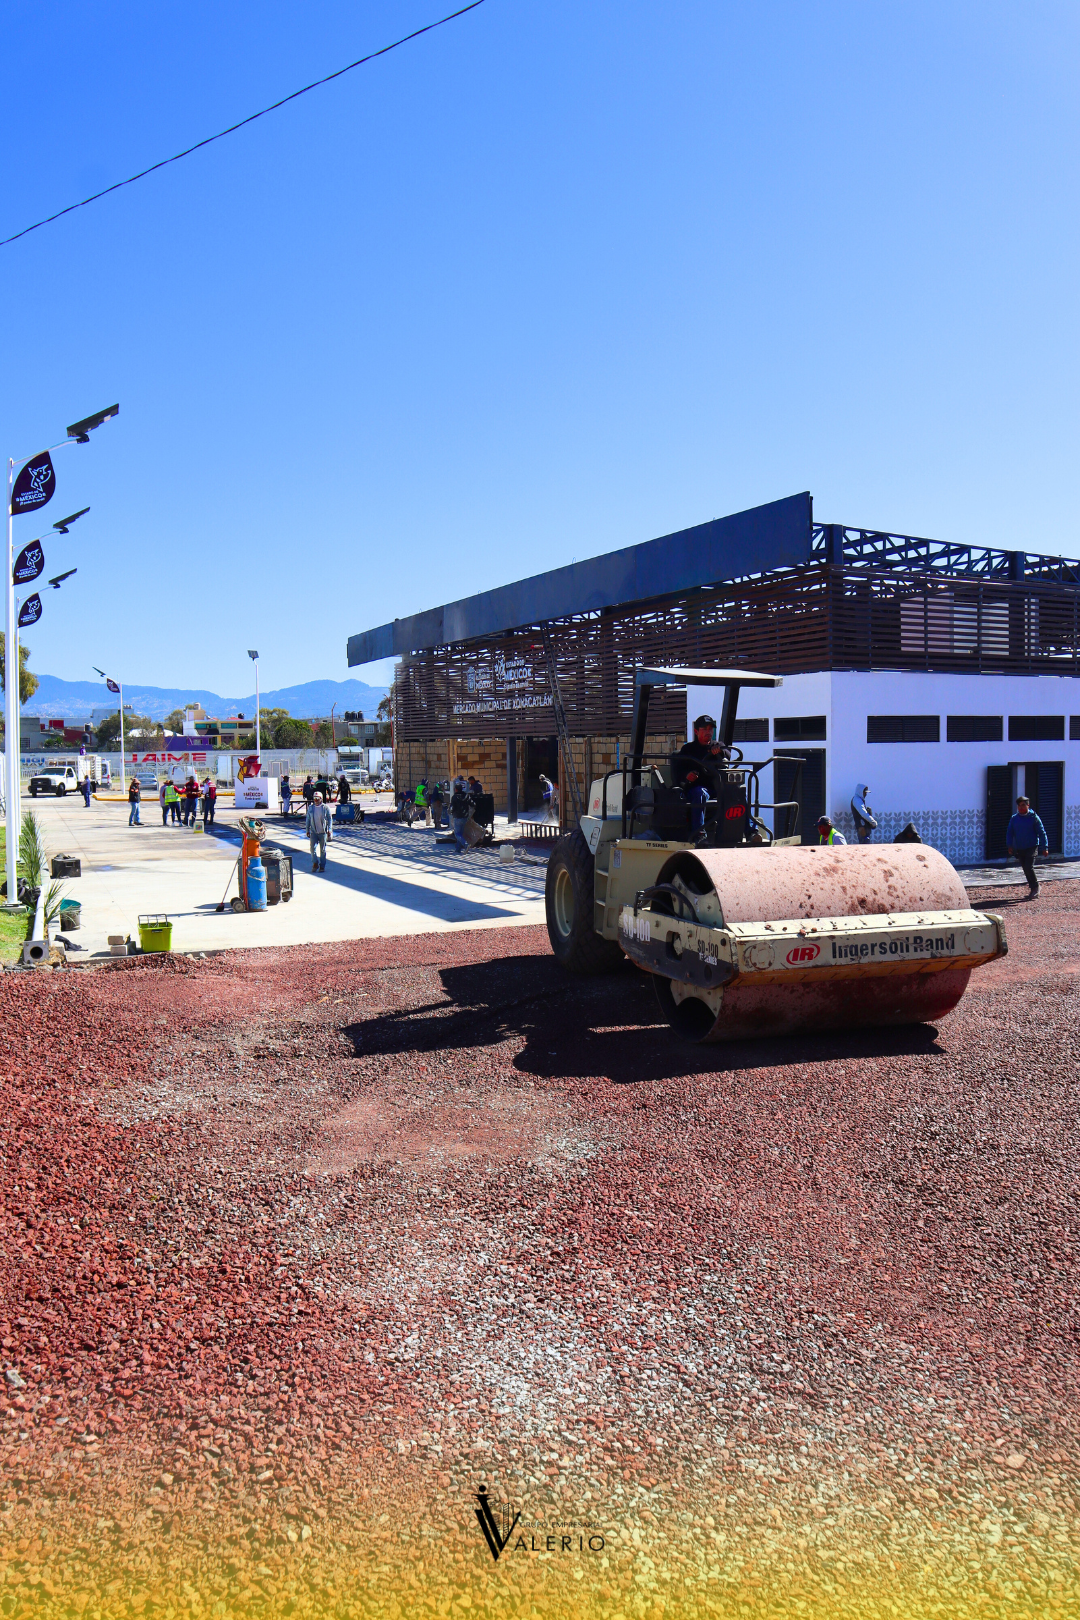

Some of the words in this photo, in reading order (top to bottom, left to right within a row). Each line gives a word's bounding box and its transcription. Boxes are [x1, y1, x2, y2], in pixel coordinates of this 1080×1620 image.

[453, 703, 477, 714] MERCADO
[476, 700, 502, 712] MUNICIPAL
[504, 699, 512, 710] DE
[116, 753, 206, 763] JAIME
[728, 806, 744, 818] IR
[623, 914, 651, 942] SD-100
[698, 939, 718, 959] SD-100
[790, 946, 816, 962] IR
[832, 936, 909, 961] Ingersoll
[913, 934, 955, 953] Rand
